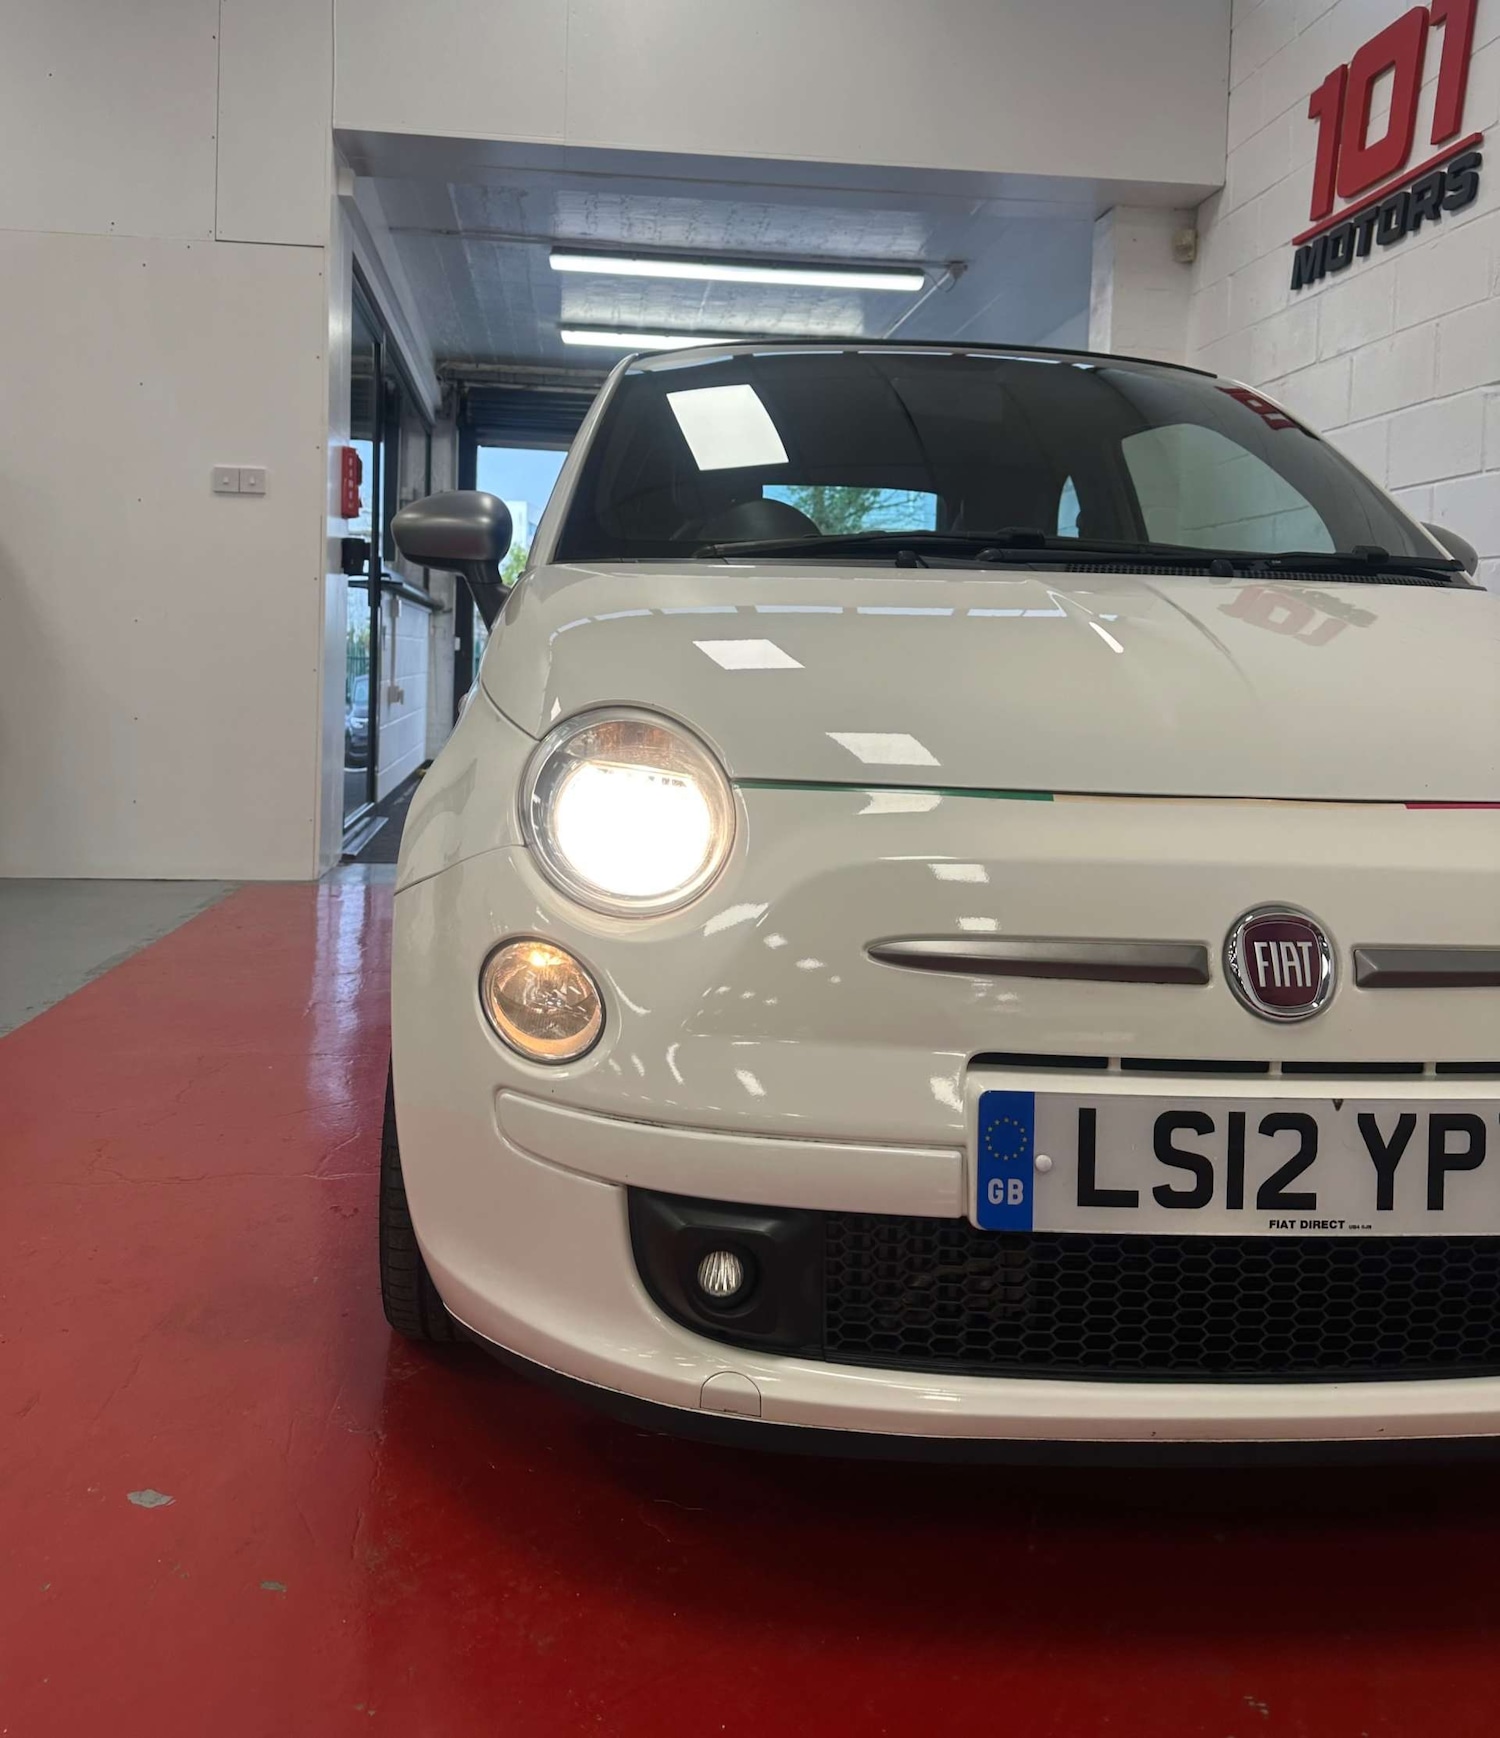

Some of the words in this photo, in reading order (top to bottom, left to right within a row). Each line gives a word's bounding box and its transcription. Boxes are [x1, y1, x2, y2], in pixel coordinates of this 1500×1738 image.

[1308, 0, 1478, 222] 101
[1290, 151, 1482, 290] MOTORS
[1254, 941, 1312, 987] FIAT
[987, 1178, 1024, 1205] GB
[1077, 1107, 1319, 1211] LS12
[1357, 1112, 1500, 1211] YP
[1269, 1220, 1296, 1229] FIAT
[1300, 1220, 1345, 1229] DIRECT
